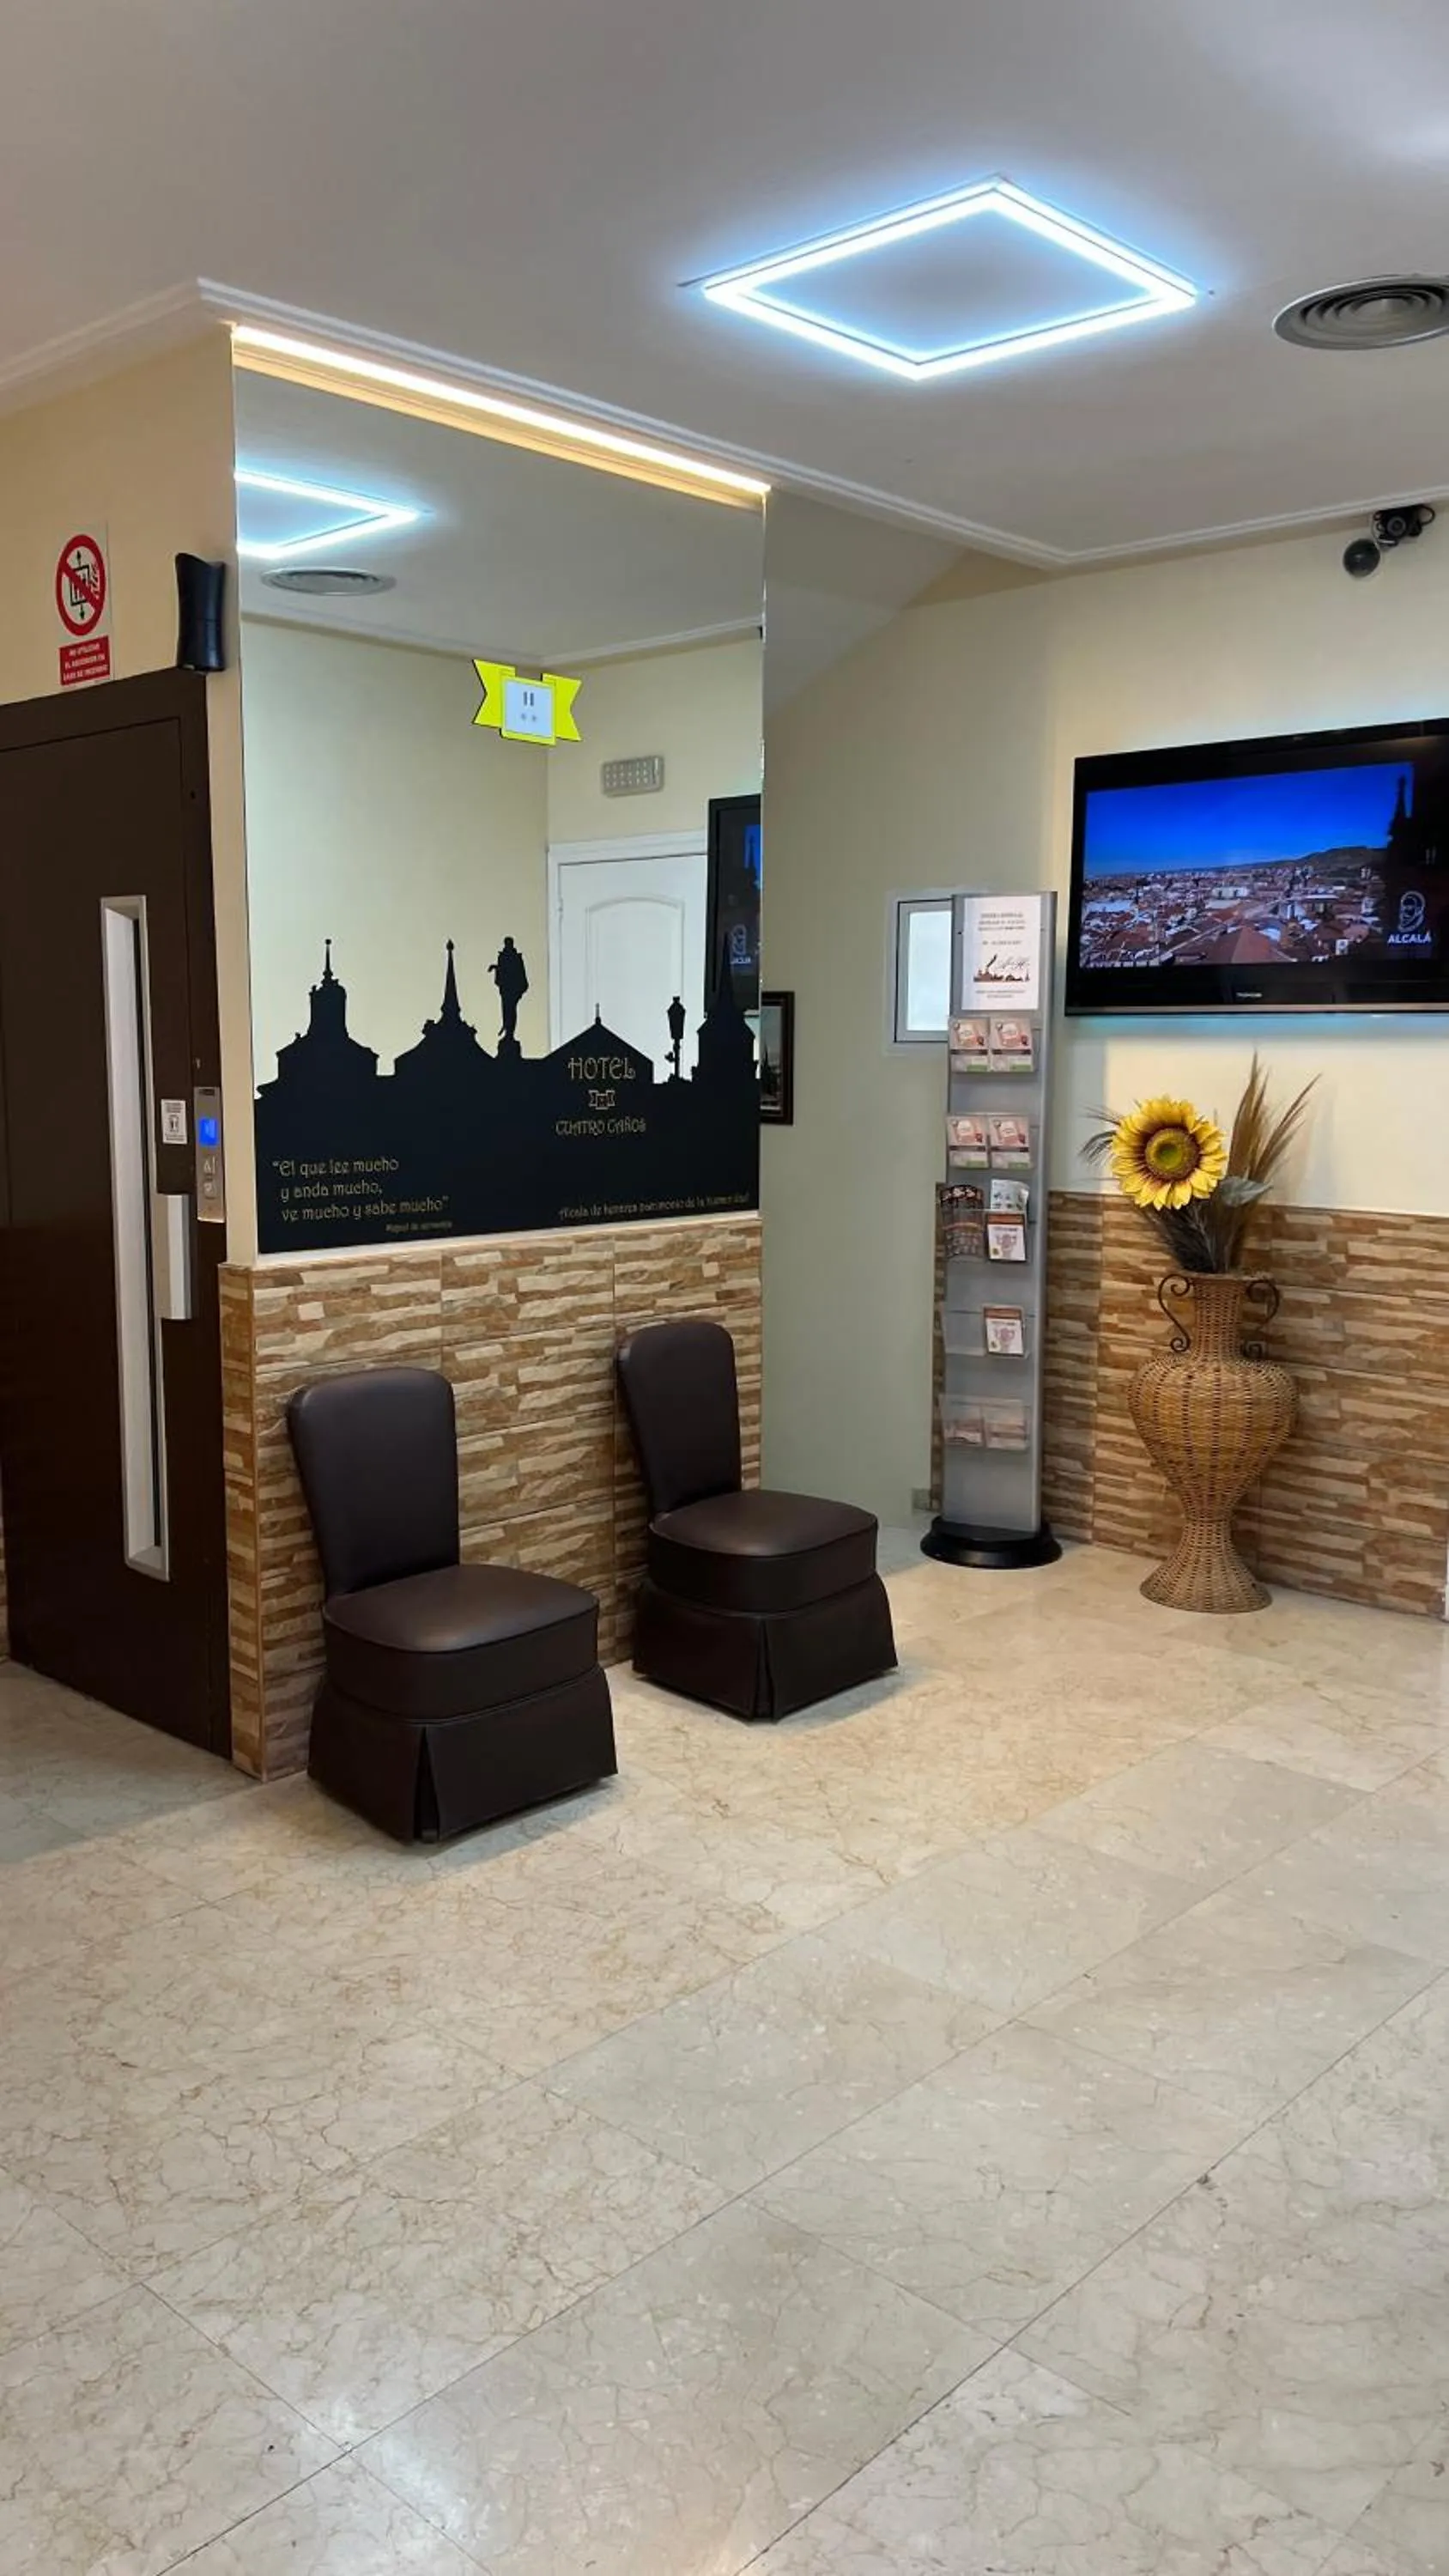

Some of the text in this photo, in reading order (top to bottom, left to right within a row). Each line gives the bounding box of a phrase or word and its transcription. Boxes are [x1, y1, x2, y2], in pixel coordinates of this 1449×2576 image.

[1387, 930, 1432, 944] ALCALÁ
[567, 1057, 636, 1079] HOTEL
[555, 1116, 646, 1136] CUATRO CAÑOS
[300, 1162, 327, 1178] que
[329, 1158, 349, 1175] lee
[353, 1156, 399, 1173] mucho
[281, 1179, 383, 1203] y anda mucho,
[281, 1208, 299, 1221] ve
[302, 1203, 349, 1220] mucho
[353, 1205, 361, 1220] y
[364, 1200, 396, 1215] sabe
